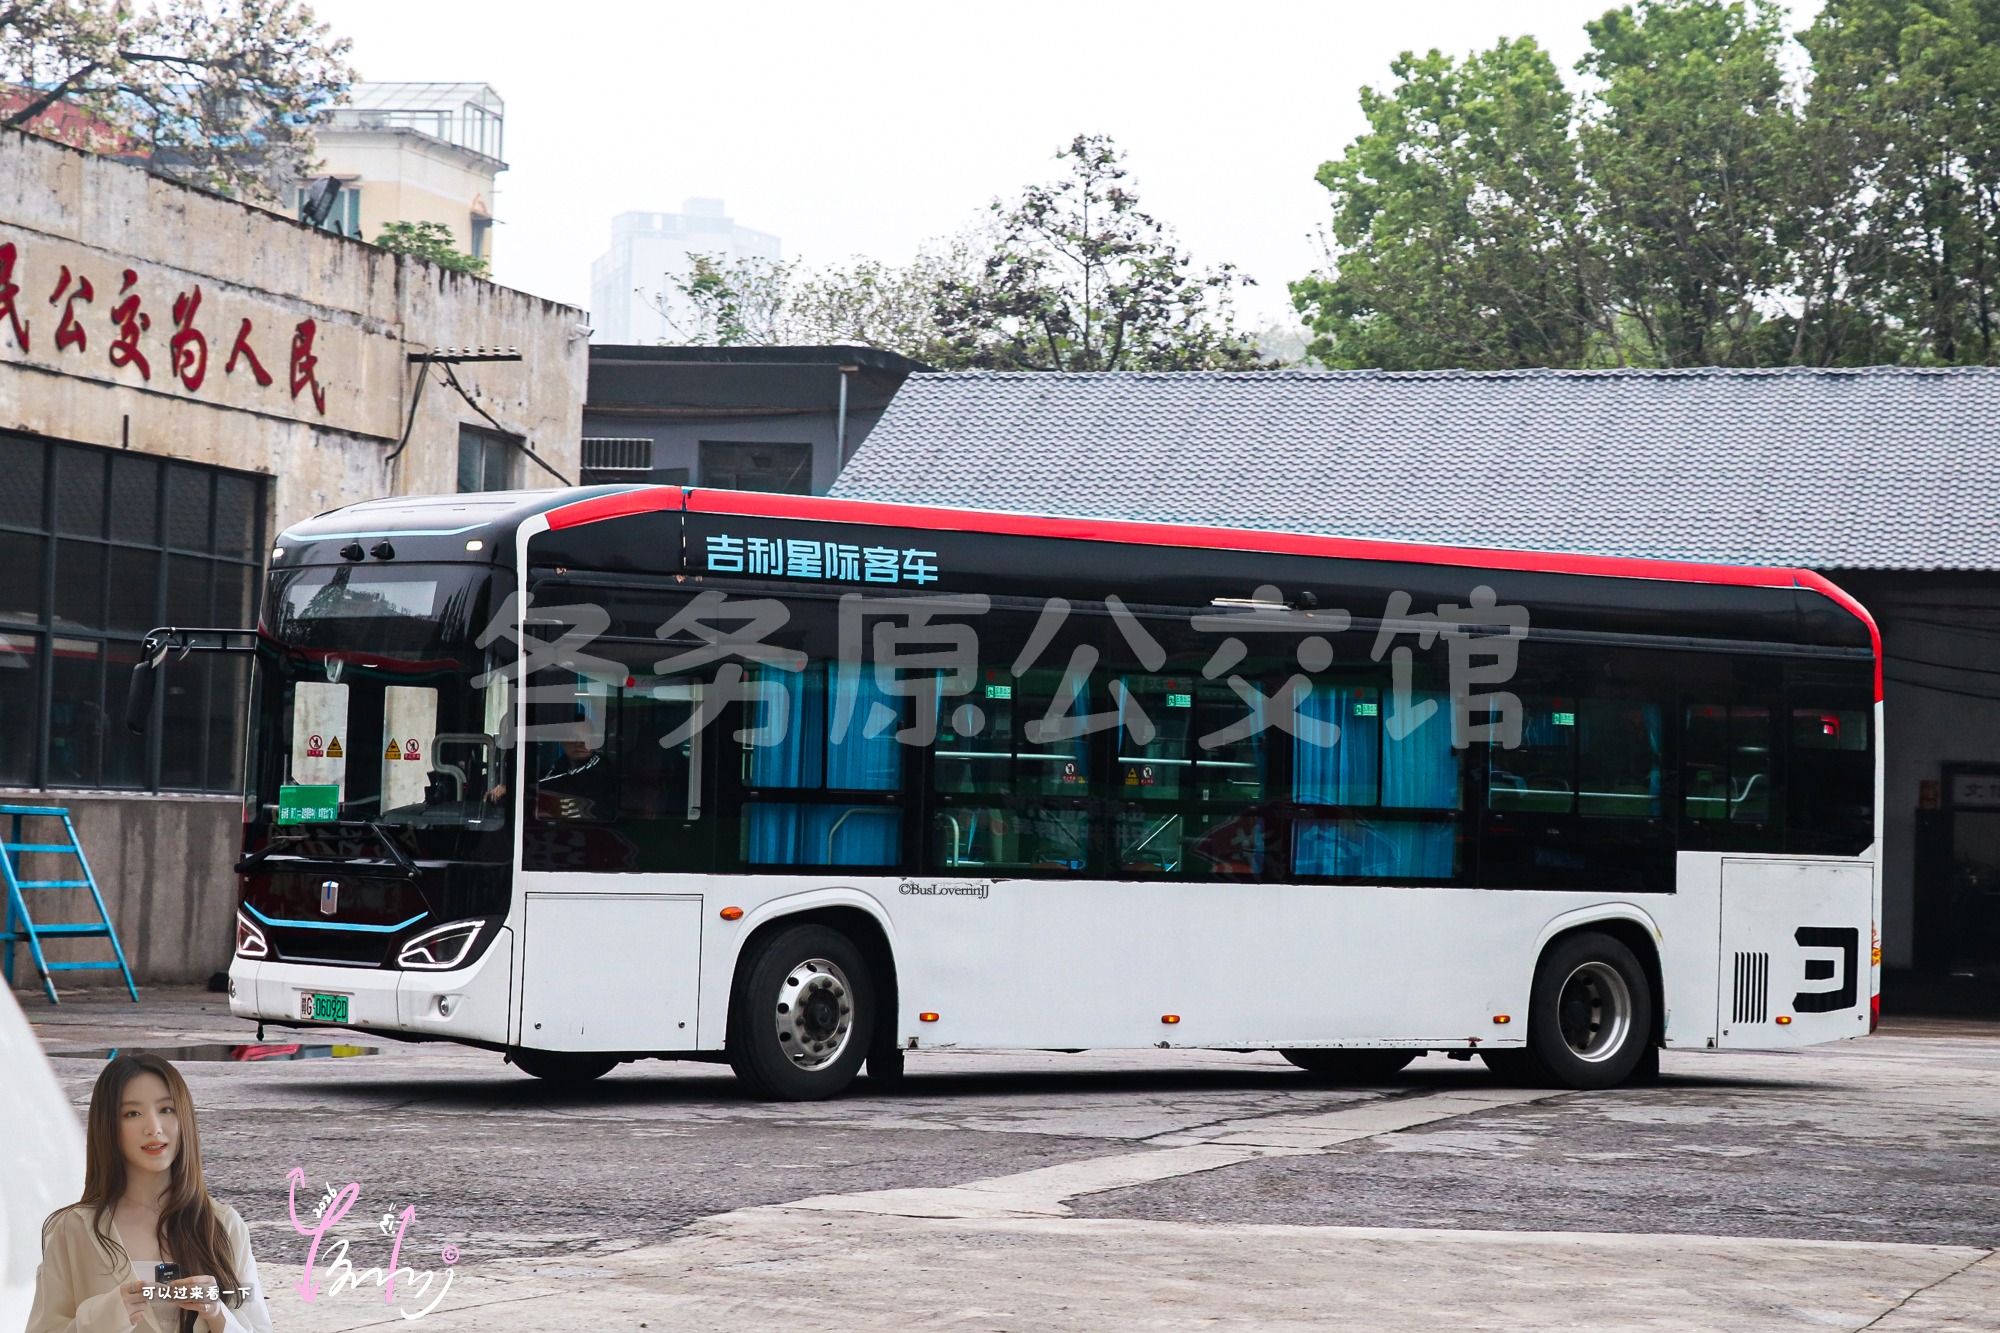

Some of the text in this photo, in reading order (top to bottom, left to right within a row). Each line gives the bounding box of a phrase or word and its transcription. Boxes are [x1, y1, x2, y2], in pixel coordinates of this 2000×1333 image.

[706, 534, 939, 584] 吉利星际客车
